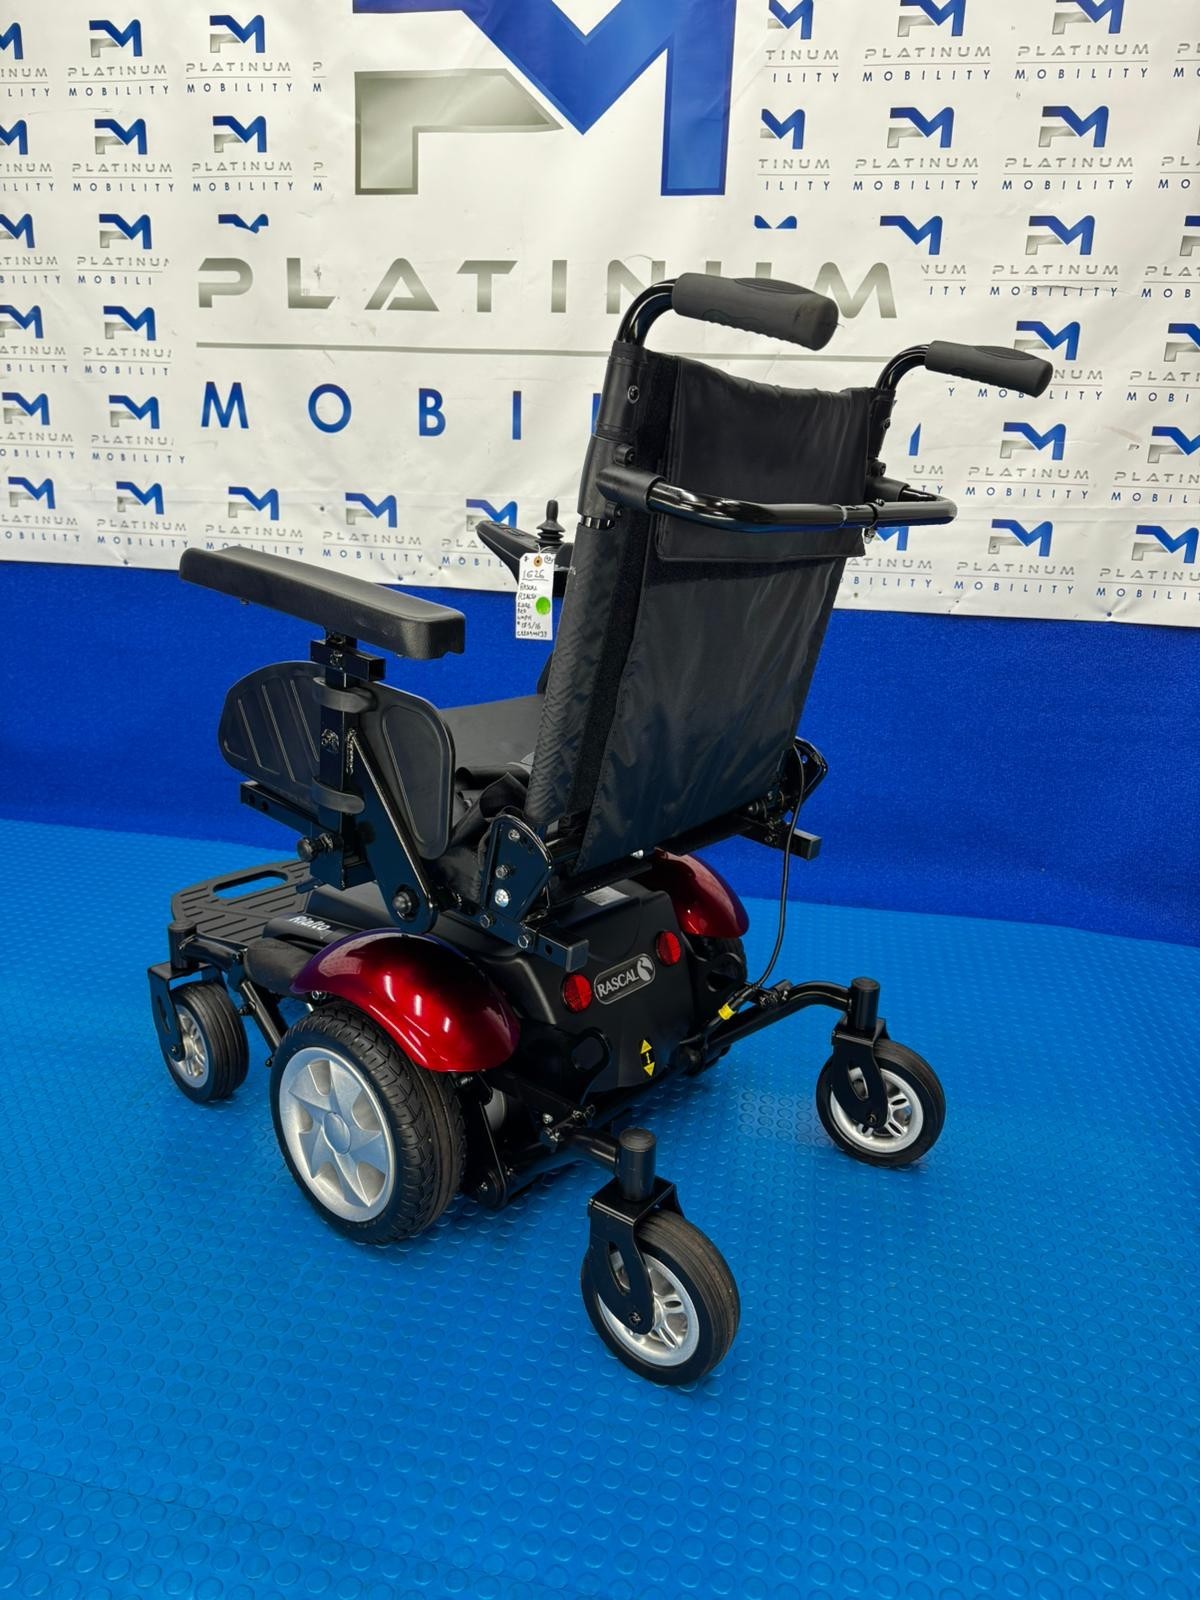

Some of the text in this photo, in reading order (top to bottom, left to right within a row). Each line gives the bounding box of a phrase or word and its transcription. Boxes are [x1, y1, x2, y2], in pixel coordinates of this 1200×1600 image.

[89, 19, 142, 57] PM
[209, 14, 265, 53] PM
[864, 46, 991, 59] PLATINUM
[1017, 43, 1149, 56] PLATINUM
[68, 64, 167, 77] PLATINUM
[185, 62, 291, 73] PLATINUM
[1015, 67, 1149, 80] MOBILITY
[863, 69, 991, 82] MOBILITY
[68, 85, 169, 97] MOBILITY
[186, 82, 293, 94] MOBILITY
[887, 106, 955, 148] PM
[1038, 105, 1109, 148] PM
[94, 118, 147, 155] PM
[213, 115, 267, 153] PM
[0, 162, 52, 173] INUM
[72, 162, 173, 173] PLATINUM
[192, 161, 293, 172] PLATINUM
[854, 157, 979, 169] PLATINUM
[1004, 156, 1134, 169] PLATINUM
[73, 182, 174, 192] MOBILITY
[192, 181, 293, 192] MOBILITY
[853, 179, 979, 192] MOBILITY
[1002, 179, 1133, 191] MOBILITY
[99, 213, 152, 250] PM
[1025, 214, 1096, 256] PM
[991, 263, 1119, 276] PLATINUM
[198, 257, 897, 319] PLATINM
[990, 285, 1118, 297] MOBILITY
[103, 305, 156, 341] PM
[978, 388, 1103, 401] MOBLITY
[109, 394, 160, 429] PM
[0, 431, 73, 442] ATINUM
[1000, 421, 1066, 461] PM
[92, 452, 186, 464] MOBILITY
[968, 466, 1089, 480] PLATINUM
[8, 476, 56, 510] PM
[116, 480, 164, 515] PM
[965, 486, 1088, 500] MOBILITY
[228, 486, 279, 521] PM
[345, 492, 397, 528] PM
[97, 518, 187, 531] PLATINUM
[204, 524, 304, 538] PLATINUM
[97, 536, 189, 548] MOBILITY
[322, 531, 422, 545] PLATINUM
[988, 518, 1053, 557] PM
[323, 549, 423, 563] MOBILITY
[956, 562, 1075, 575] PLATINUM
[954, 580, 1074, 595] MOBILITY
[598, 970, 639, 997] RASCAL
